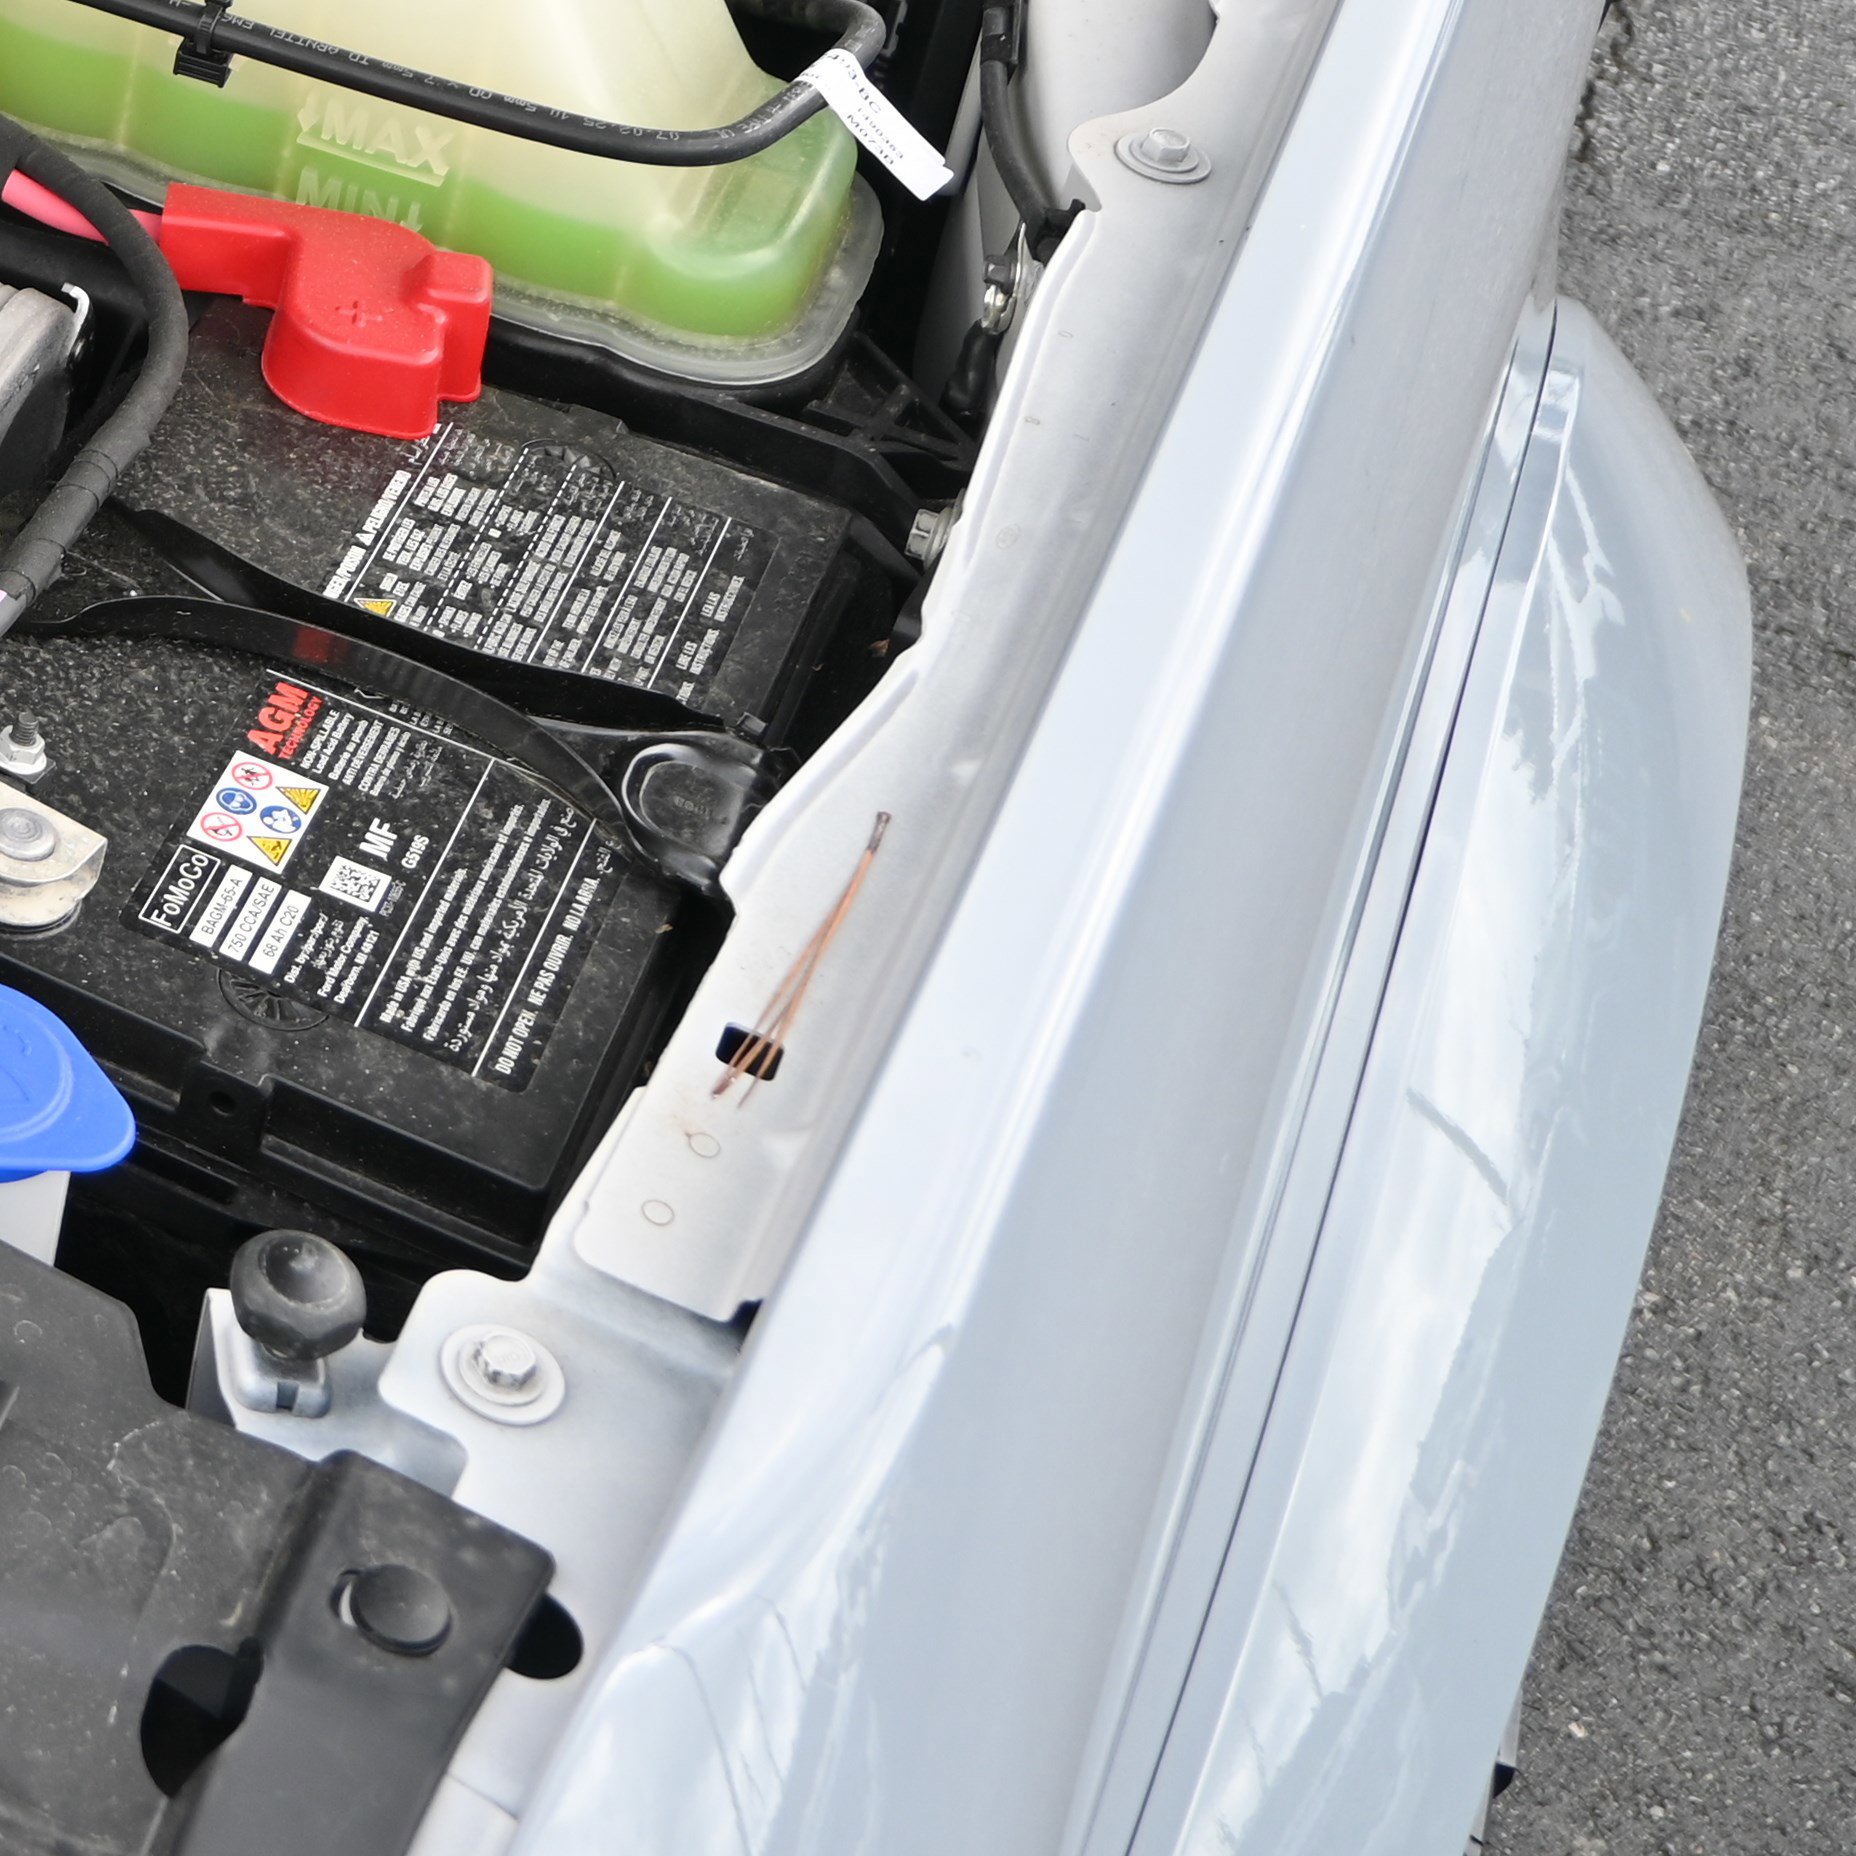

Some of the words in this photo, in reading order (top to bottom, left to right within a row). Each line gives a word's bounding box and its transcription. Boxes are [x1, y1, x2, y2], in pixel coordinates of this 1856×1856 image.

[321, 95, 456, 176] MAX
[243, 679, 309, 754] AGM
[278, 694, 324, 762] TECHNOLOGY
[357, 816, 404, 860] MF
[401, 833, 431, 871] G519S
[150, 849, 211, 929] FoMoCo
[199, 874, 244, 936] BAGM-65-A
[225, 930, 249, 954] 750
[237, 881, 276, 933] CCA/SAE
[277, 903, 300, 927] C20
[569, 900, 591, 918] LA
[268, 924, 289, 943] Ah
[562, 912, 585, 932] NO
[260, 940, 280, 958] 68
[532, 967, 558, 992] PAS
[525, 986, 549, 1006] NE
[499, 1032, 525, 1057] NOT
[491, 1051, 516, 1074] DO
